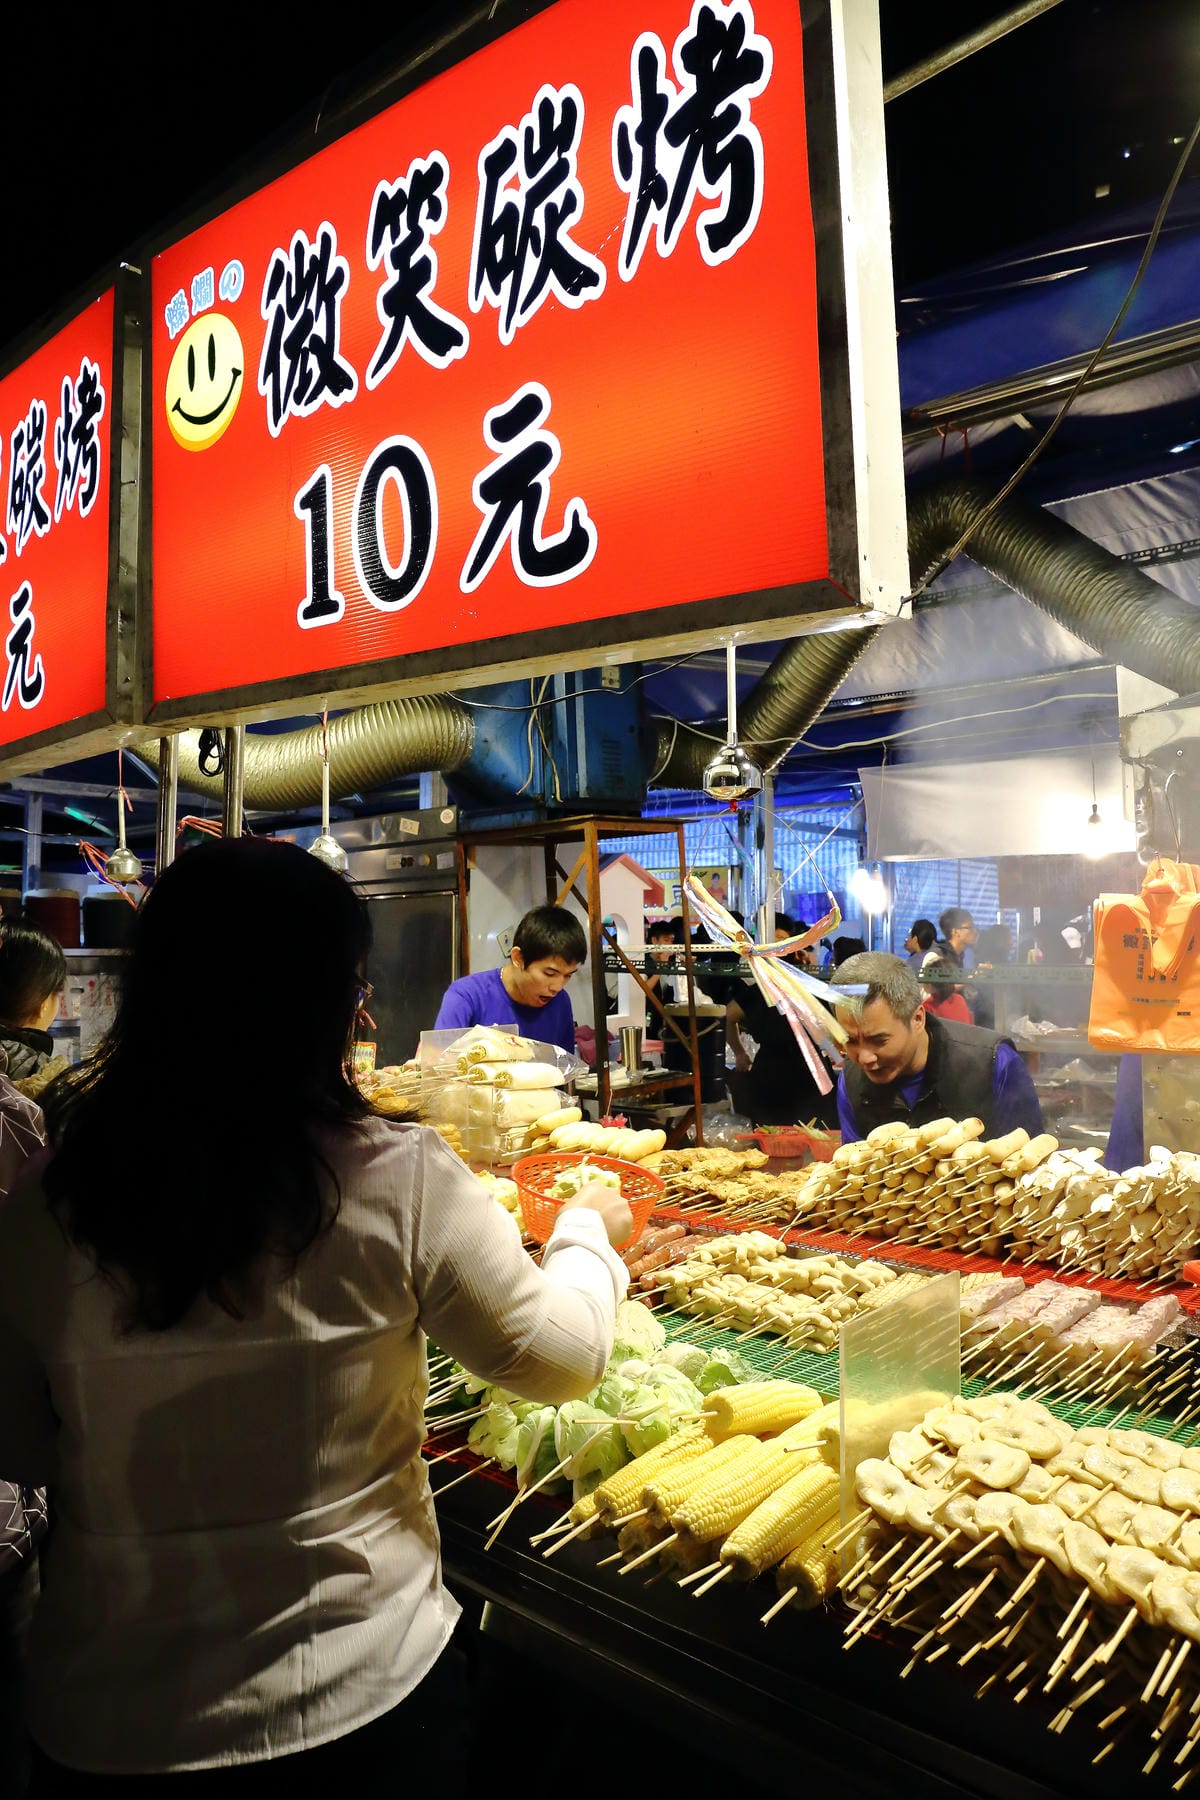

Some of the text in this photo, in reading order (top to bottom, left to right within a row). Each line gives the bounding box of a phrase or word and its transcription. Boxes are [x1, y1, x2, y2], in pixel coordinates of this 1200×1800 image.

[259, 0, 771, 437] 微笑碳烤
[0, 357, 104, 565] 碳烤
[296, 382, 598, 629] 10元
[2, 580, 45, 711] 元
